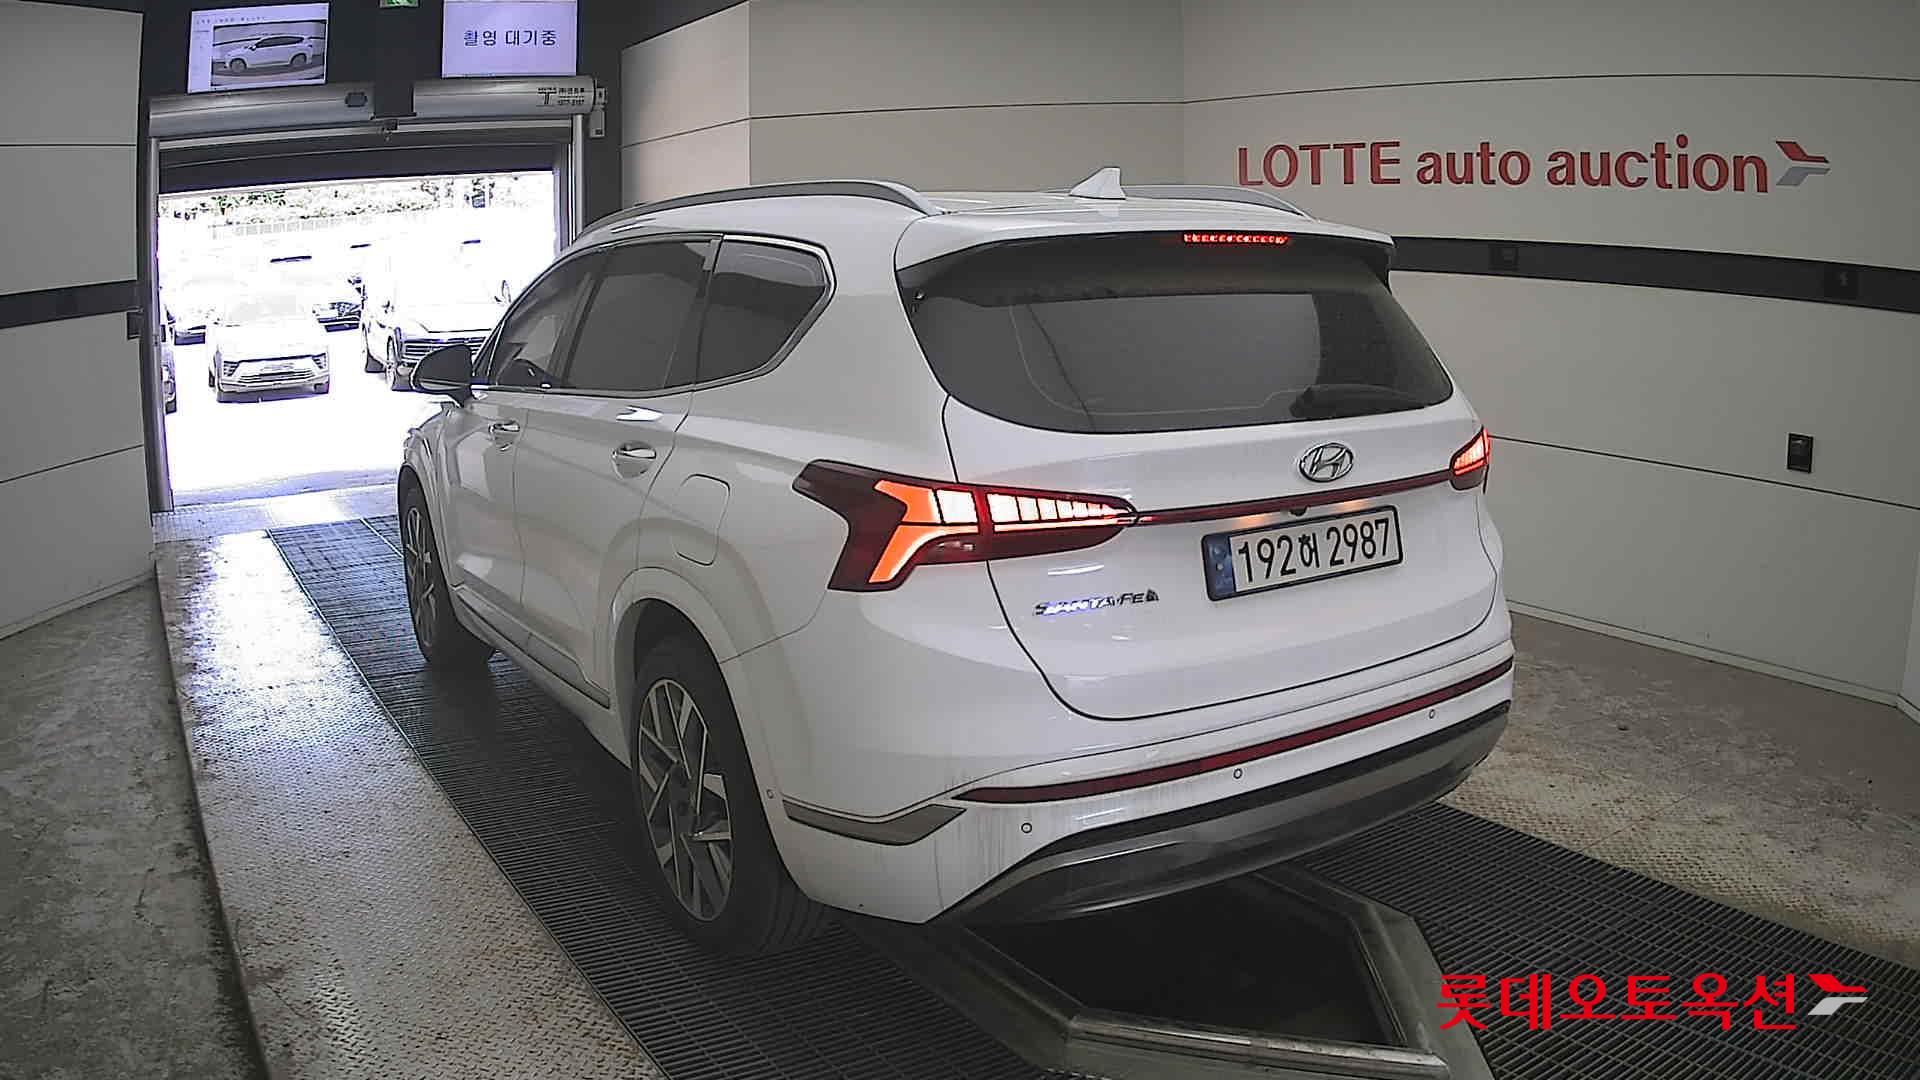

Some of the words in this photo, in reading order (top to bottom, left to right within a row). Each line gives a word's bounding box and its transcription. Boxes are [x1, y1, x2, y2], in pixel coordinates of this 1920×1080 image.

[505, 30, 557, 46] 대기중
[1238, 142, 1400, 187] LOTTE
[1416, 141, 1531, 186] auto
[1547, 134, 1769, 193] auction
[1238, 532, 1320, 583] 192허
[1326, 517, 1390, 568] 2987
